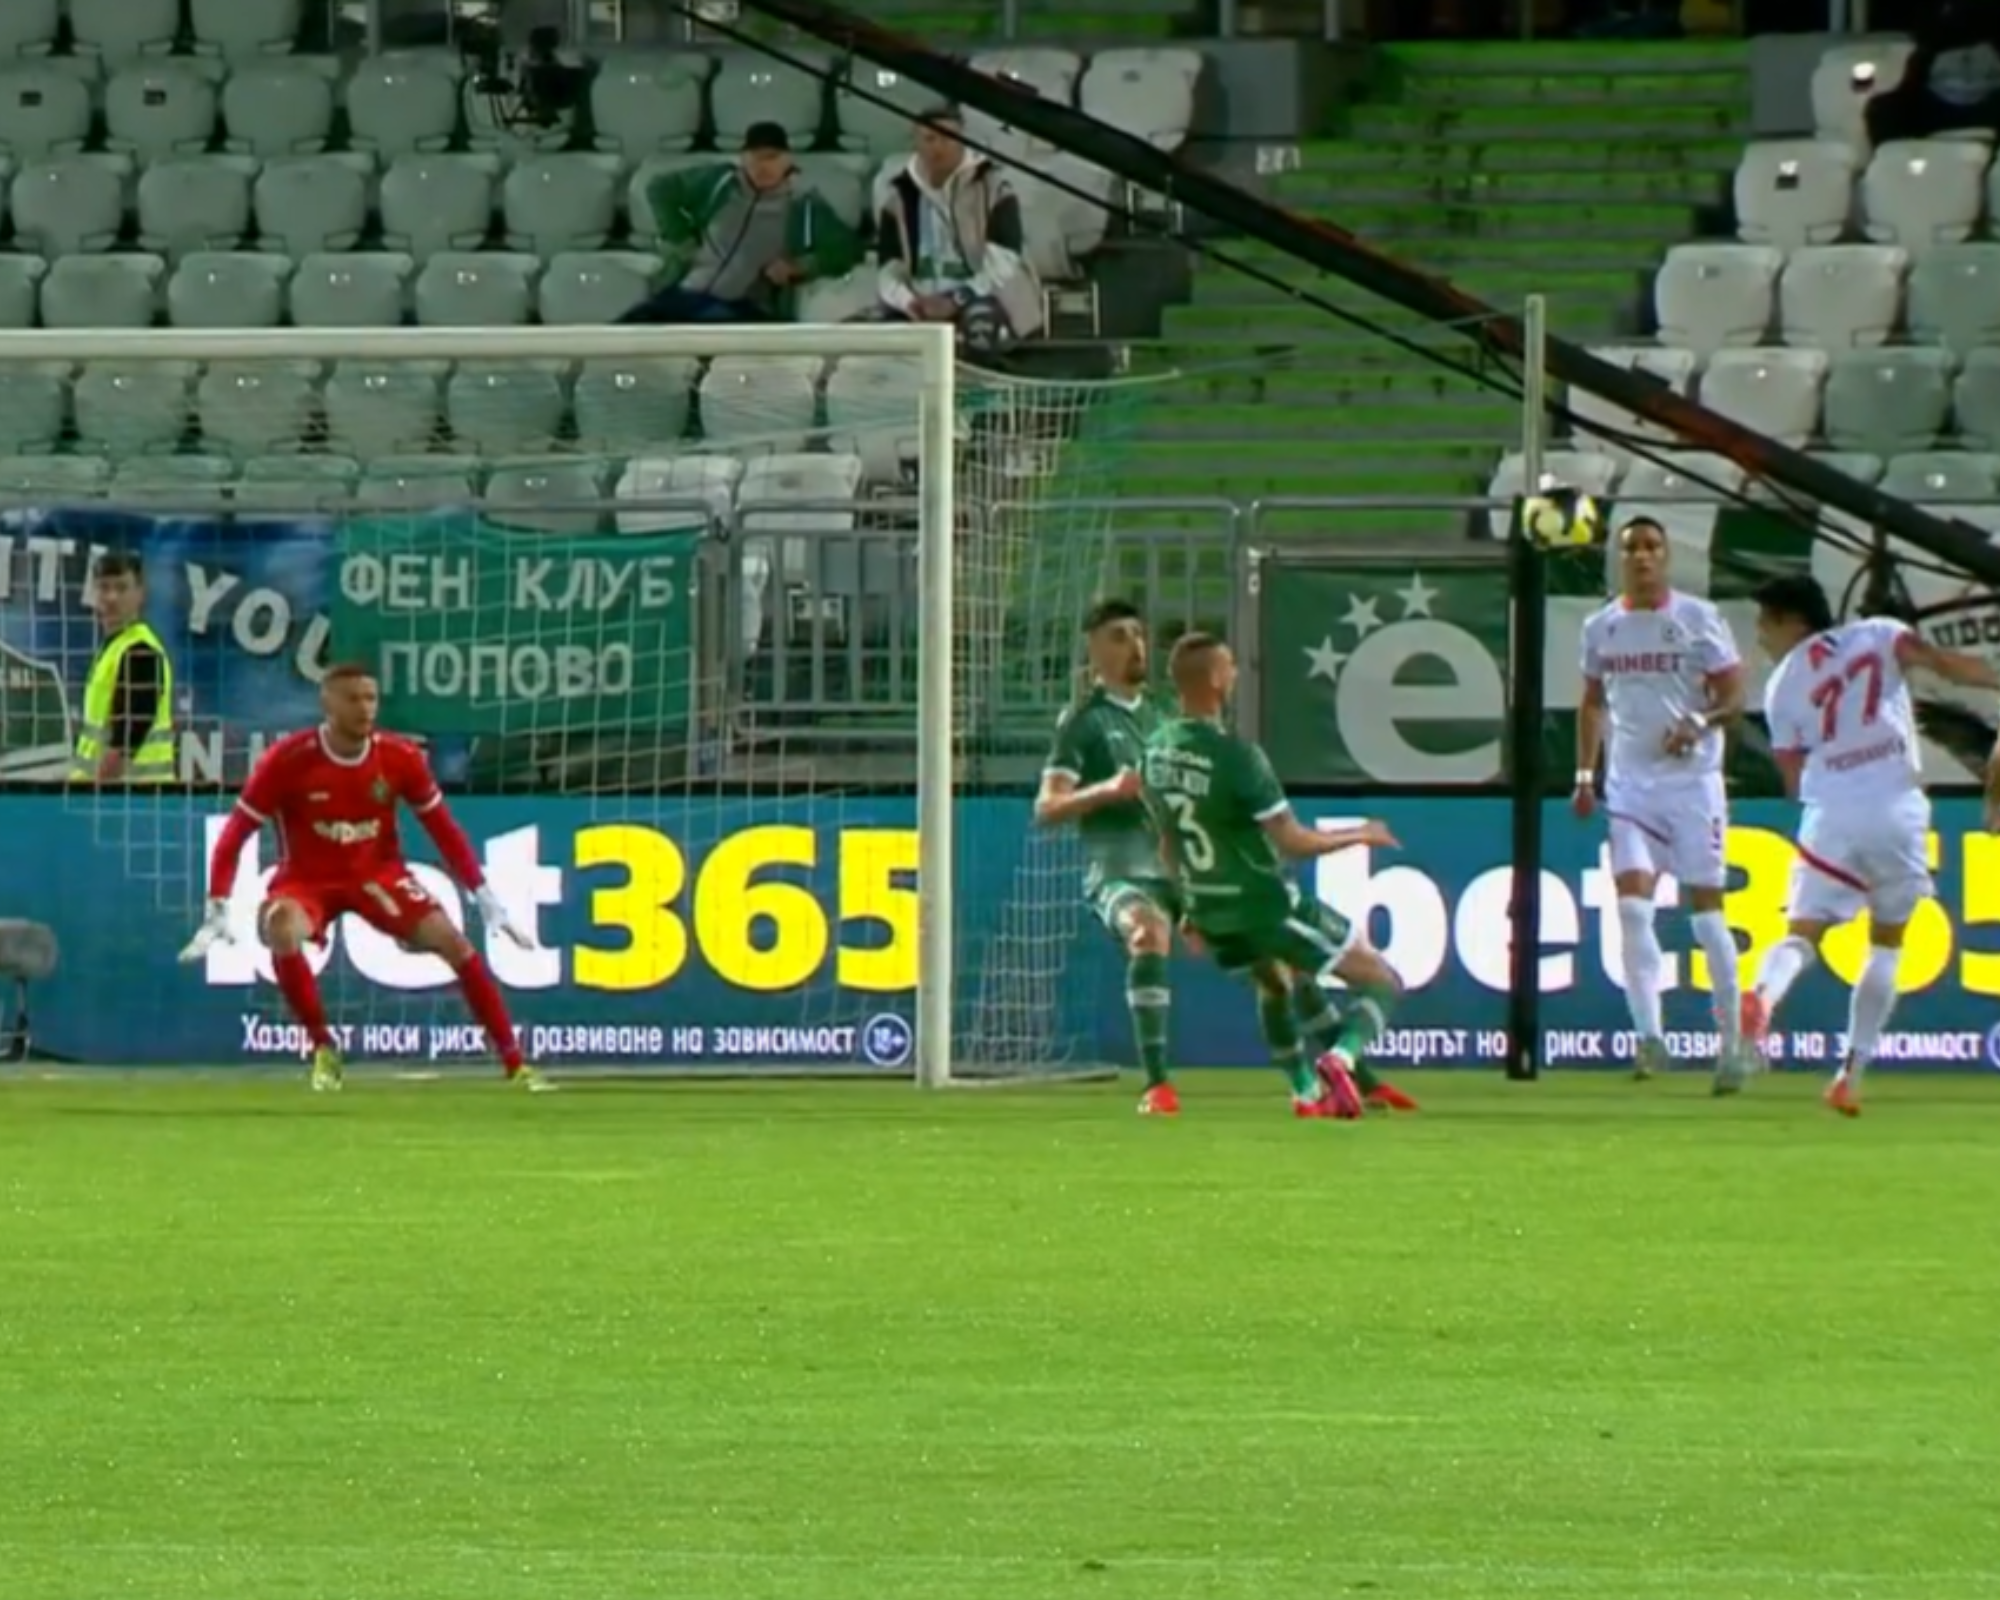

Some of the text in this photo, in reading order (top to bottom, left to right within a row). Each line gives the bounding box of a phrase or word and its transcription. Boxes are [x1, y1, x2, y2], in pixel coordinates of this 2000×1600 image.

[340, 552, 675, 609] ФЕН КЛУБ
[380, 641, 633, 697] ПОПОВО
[1811, 651, 1882, 742] 77
[1162, 792, 1215, 872] 3
[363, 1025, 420, 1051] носи
[429, 1025, 487, 1060] риск
[532, 1025, 663, 1059] развиване
[673, 1025, 704, 1053] на
[713, 1025, 856, 1053] зависимост
[1364, 1030, 1468, 1065] азартът
[1544, 1030, 1604, 1066] риск
[1793, 1031, 1825, 1057] на
